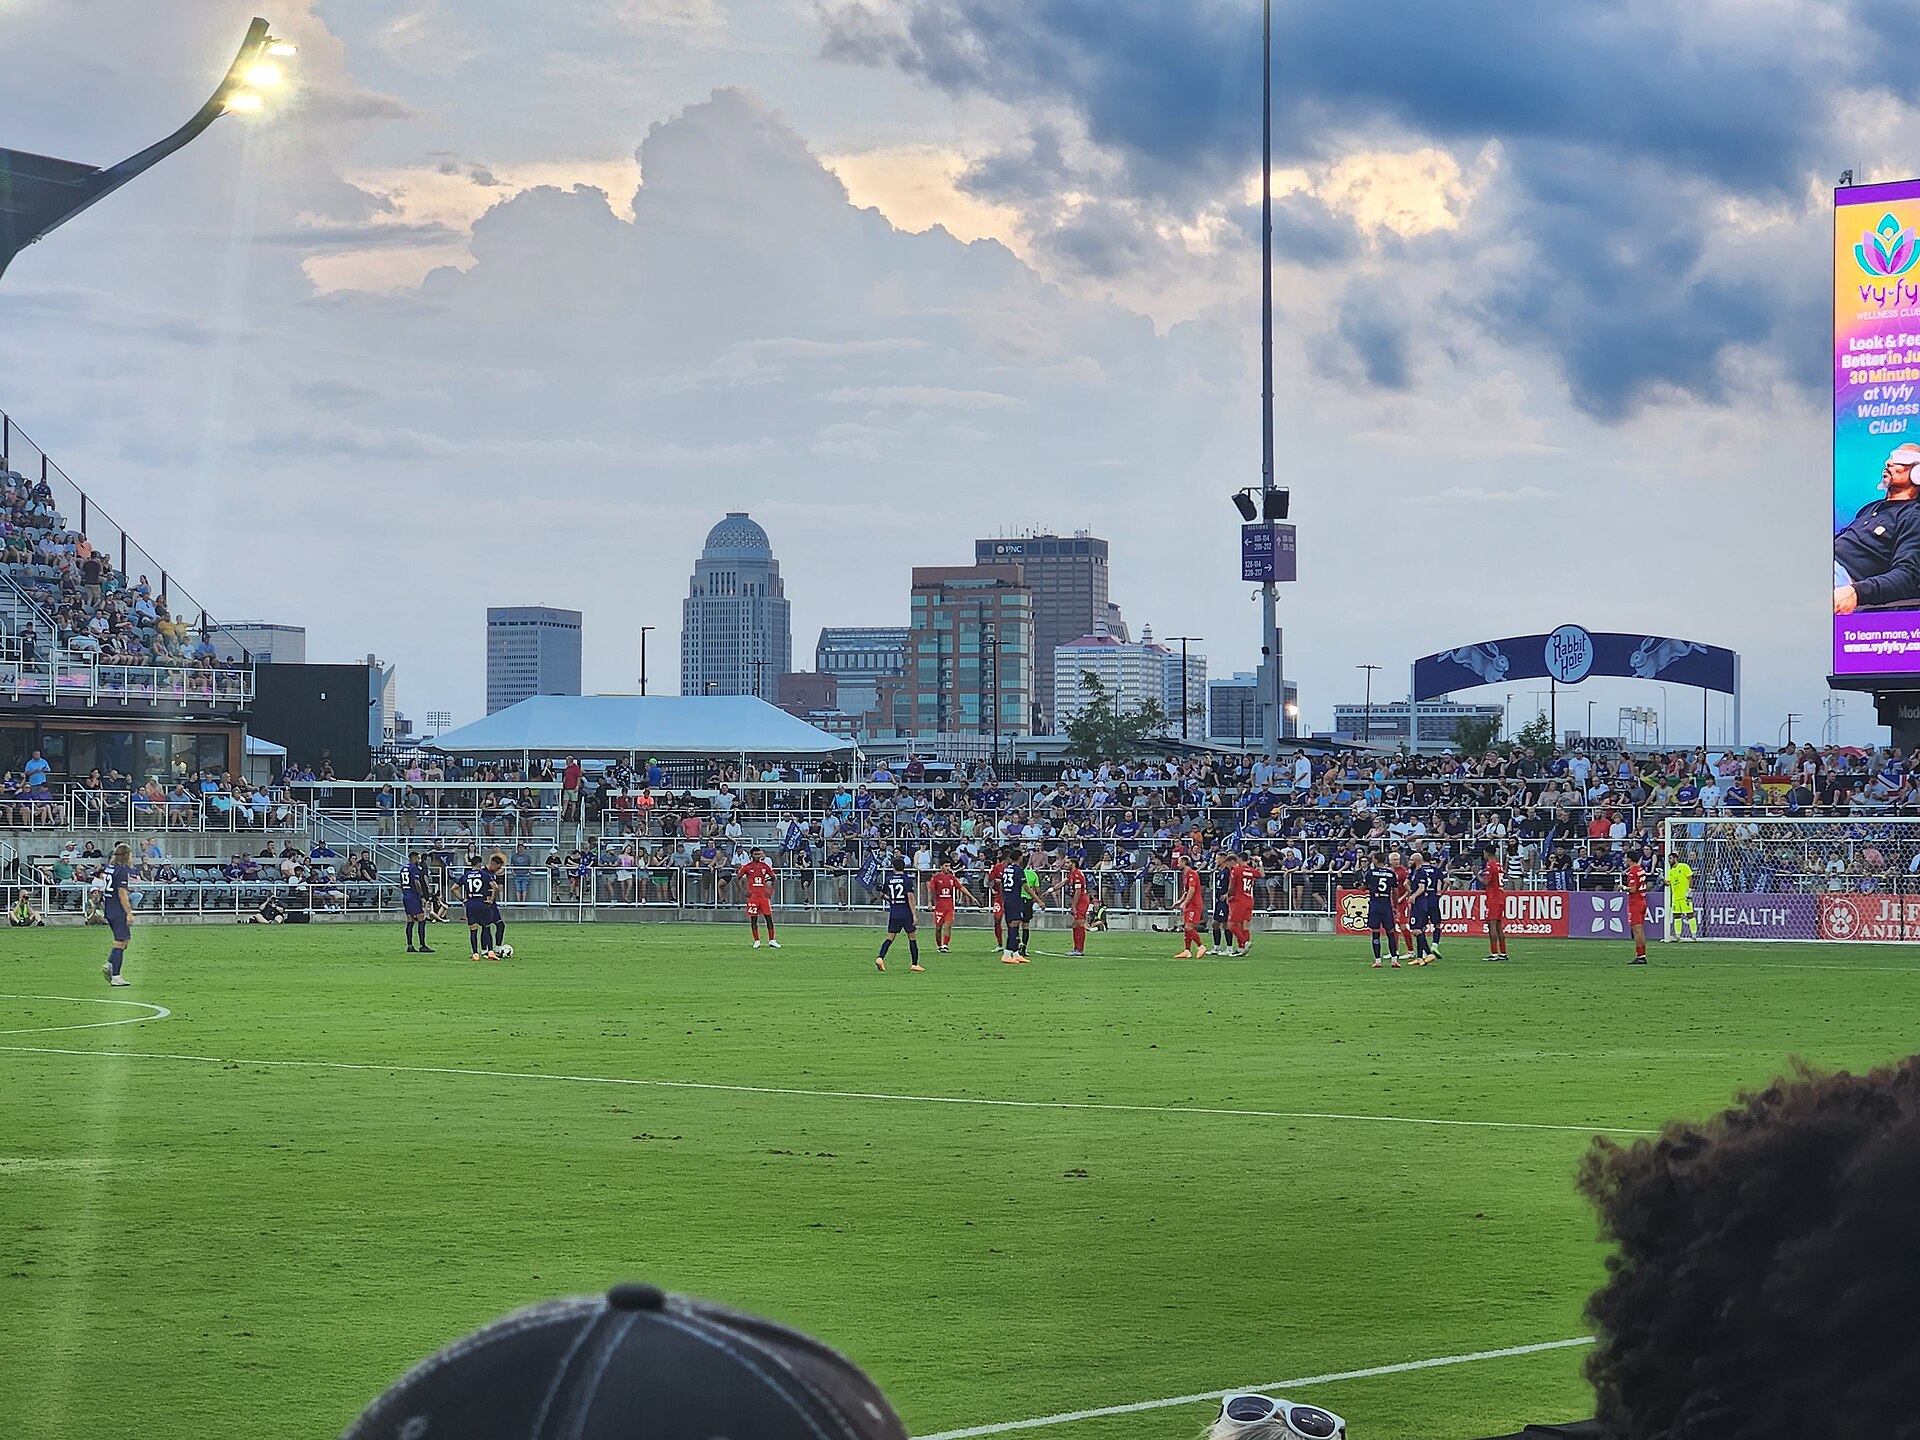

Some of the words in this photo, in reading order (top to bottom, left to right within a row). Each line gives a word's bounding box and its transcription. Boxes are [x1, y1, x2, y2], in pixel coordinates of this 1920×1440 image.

[1856, 310, 1899, 320] WELLNESS
[1849, 336, 1883, 350] Look
[1885, 335, 1897, 347] &
[1842, 352, 1886, 368] Better
[1887, 350, 1902, 364] in
[1849, 369, 1868, 385] 30
[1863, 386, 1880, 401] at
[1882, 384, 1914, 402] Vyfy
[1858, 403, 1919, 417] Wellness
[1869, 419, 1907, 434] Club!
[1004, 545, 1022, 553] PNC
[1843, 630, 1857, 640] To
[1857, 630, 1882, 641] learn
[1882, 630, 1910, 640] more,
[1552, 633, 1586, 666] Rabbit
[1561, 645, 1583, 681] Hole
[401, 871, 410, 885] 13
[467, 879, 483, 892] 19
[1003, 873, 1014, 888] 23
[1378, 878, 1387, 891] 5
[888, 884, 905, 899] 12
[1479, 895, 1562, 920] ROFING
[936, 916, 942, 924] 7
[1711, 907, 1786, 925] HEALTH
[1482, 924, 1552, 934] 5.425.2928
